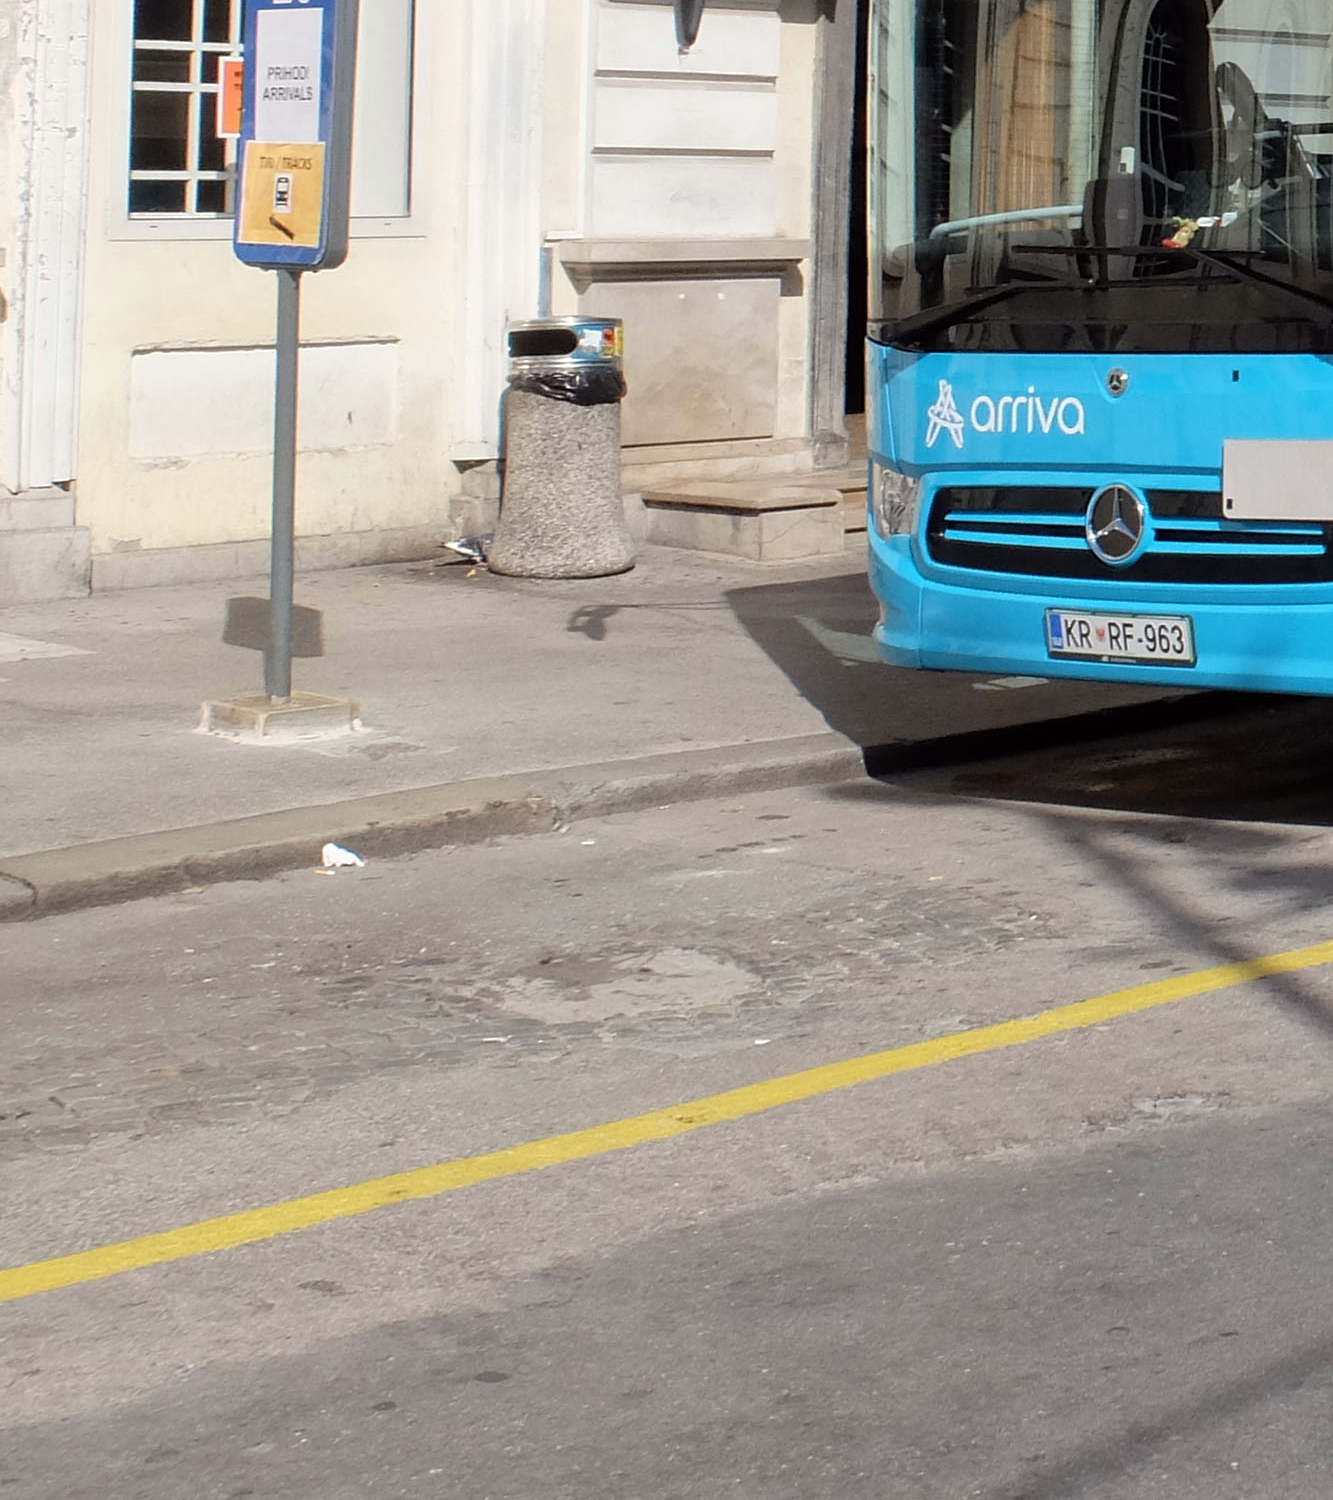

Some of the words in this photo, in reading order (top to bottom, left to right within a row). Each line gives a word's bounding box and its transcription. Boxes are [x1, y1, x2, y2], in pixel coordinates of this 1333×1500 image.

[267, 66, 310, 80] PRIHODI
[262, 86, 313, 101] ARRIVALS
[970, 385, 1085, 436] arriva
[1064, 619, 1093, 649] KR
[1107, 621, 1185, 654] RF-963
